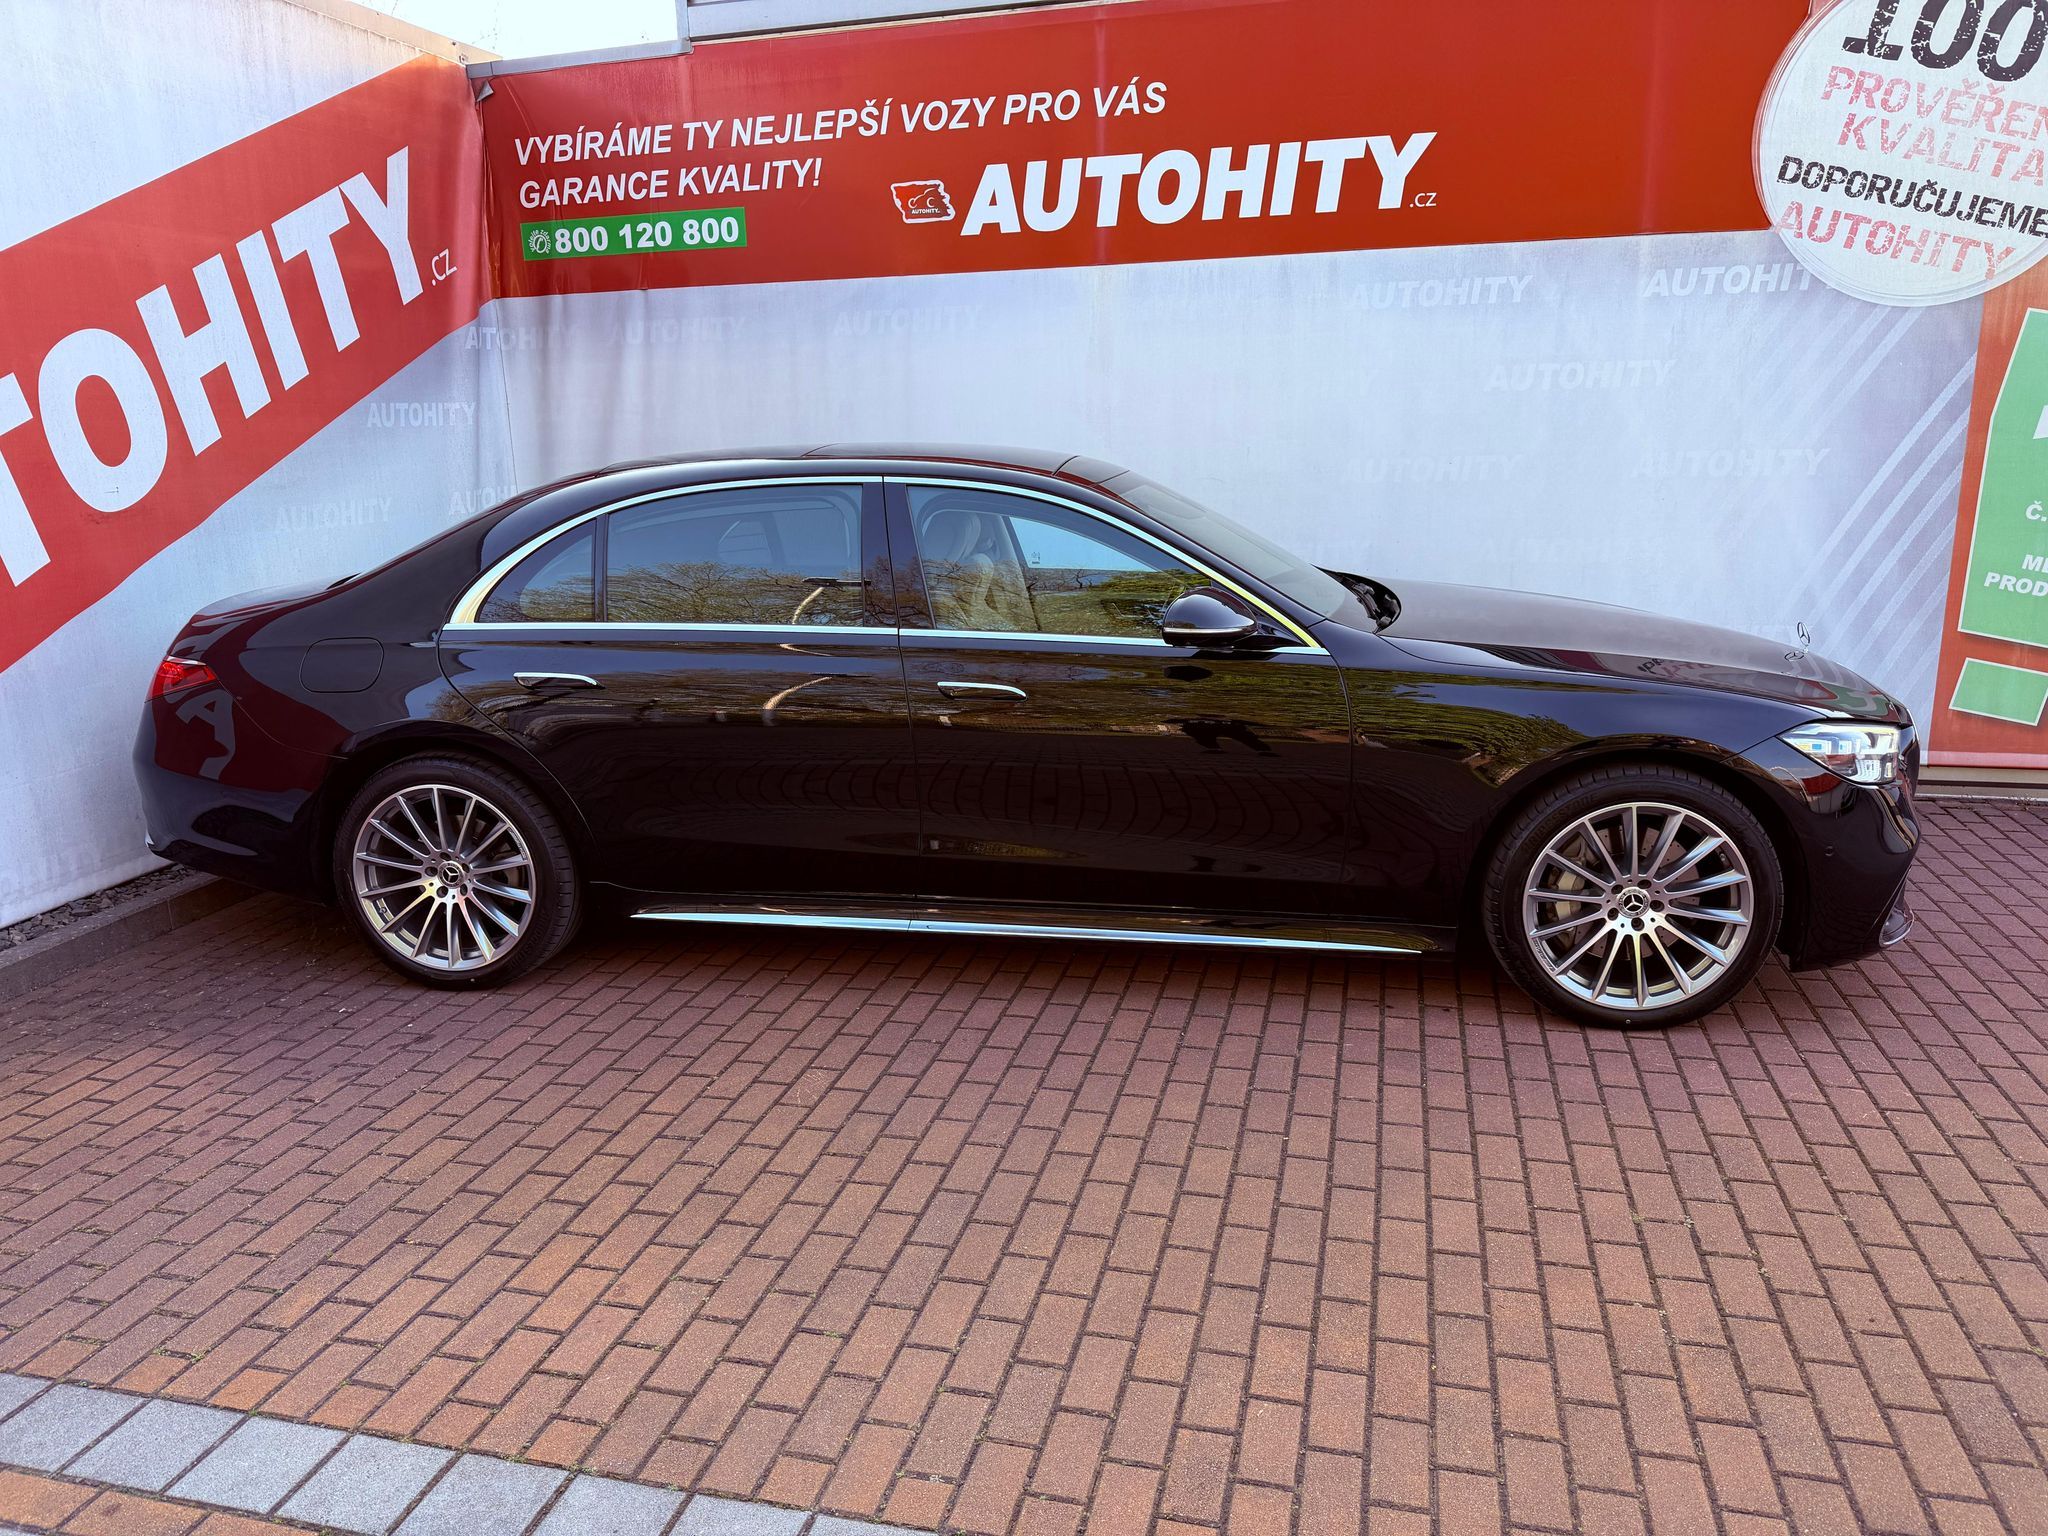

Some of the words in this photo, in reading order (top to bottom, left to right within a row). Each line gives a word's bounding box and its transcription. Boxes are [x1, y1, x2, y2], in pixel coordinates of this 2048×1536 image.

[514, 122, 672, 165] VYBÍRÁME
[682, 120, 723, 150] TY
[731, 98, 893, 147] NEJLEPŠÍ
[900, 96, 996, 133] VOZY
[1003, 89, 1081, 125] PRO
[1093, 76, 1168, 117] VÁS
[1837, 112, 2046, 187] KVALITA
[519, 169, 669, 209] GARANCE
[678, 157, 822, 197] KVALITY!
[960, 131, 1437, 236] AUTOHITY
[1777, 155, 2048, 239] DOPORUČUJEME
[555, 225, 609, 254] 800
[618, 221, 672, 249] 120
[682, 216, 739, 246] 800
[1771, 199, 2016, 281] AUTOHITY
[1347, 273, 1534, 310] AUTOHITY
[1642, 262, 1831, 298] AUTOHIT
